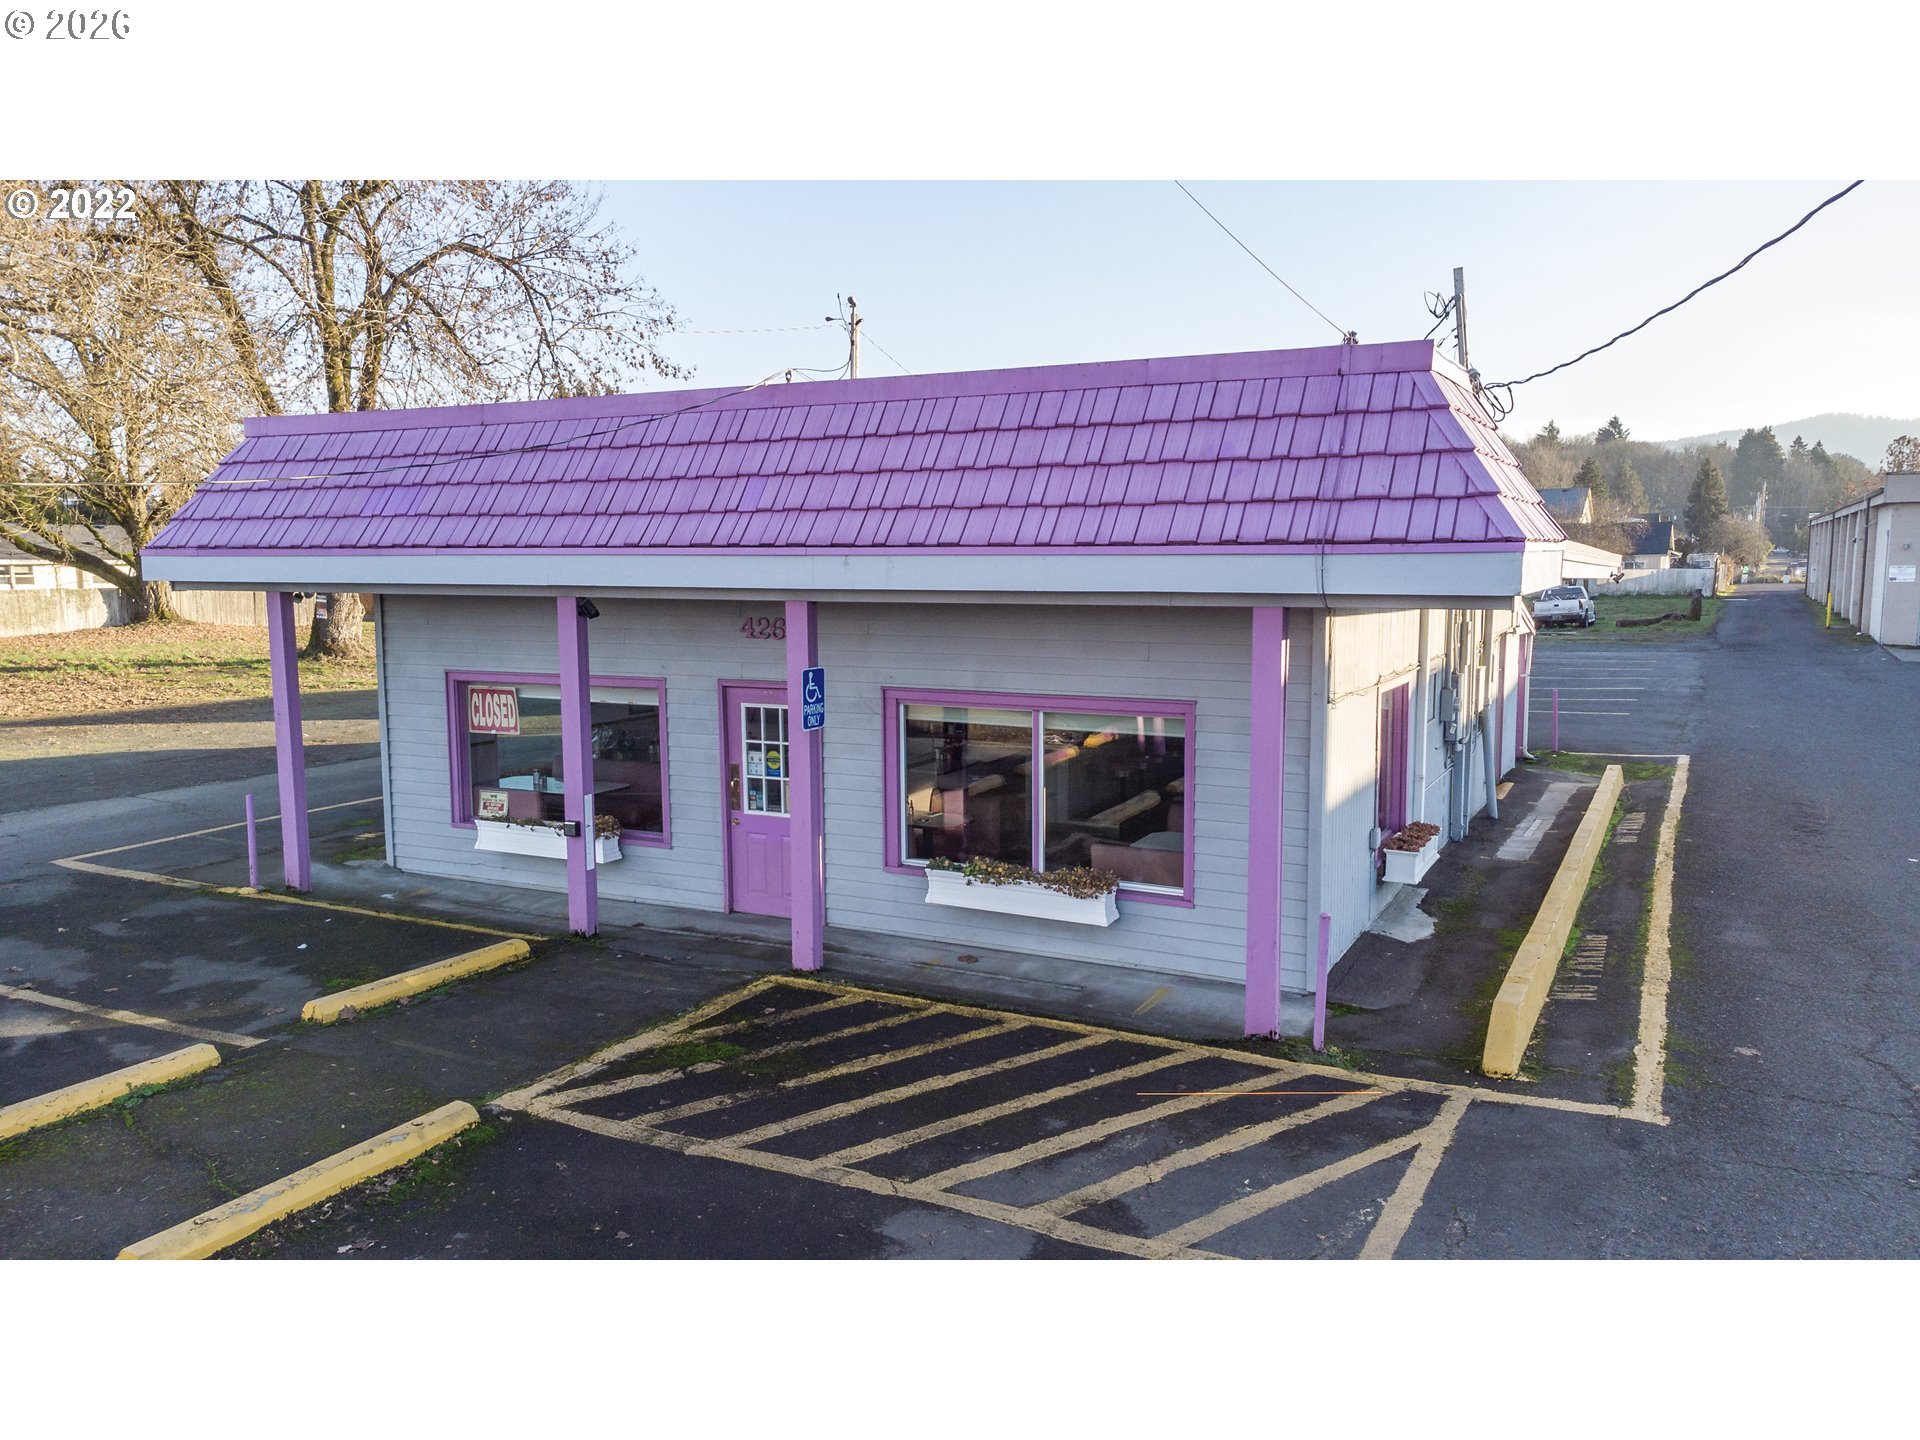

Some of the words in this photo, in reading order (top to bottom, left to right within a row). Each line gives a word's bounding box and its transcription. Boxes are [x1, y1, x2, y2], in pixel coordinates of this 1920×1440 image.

[740, 616, 786, 640] 426
[471, 692, 516, 728] CLOSED
[804, 702, 824, 716] PARKING
[807, 715, 821, 727] ONLY
